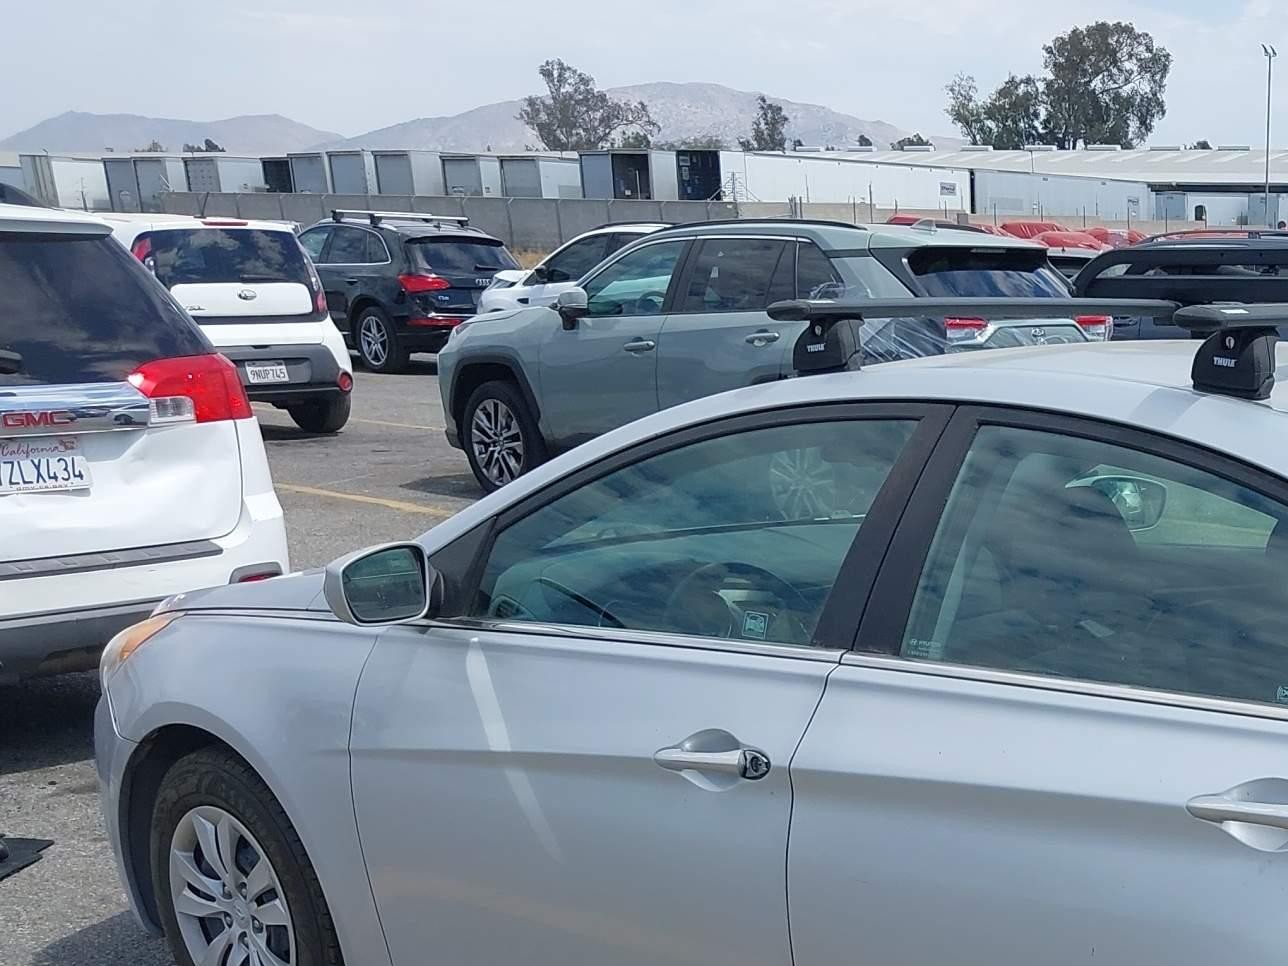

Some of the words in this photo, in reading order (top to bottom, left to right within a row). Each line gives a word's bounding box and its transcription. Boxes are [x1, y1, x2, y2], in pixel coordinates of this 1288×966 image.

[250, 367, 287, 381] 9NUP745
[2, 411, 72, 428] GMC
[0, 441, 64, 458] California
[0, 456, 84, 487] ZLX434
